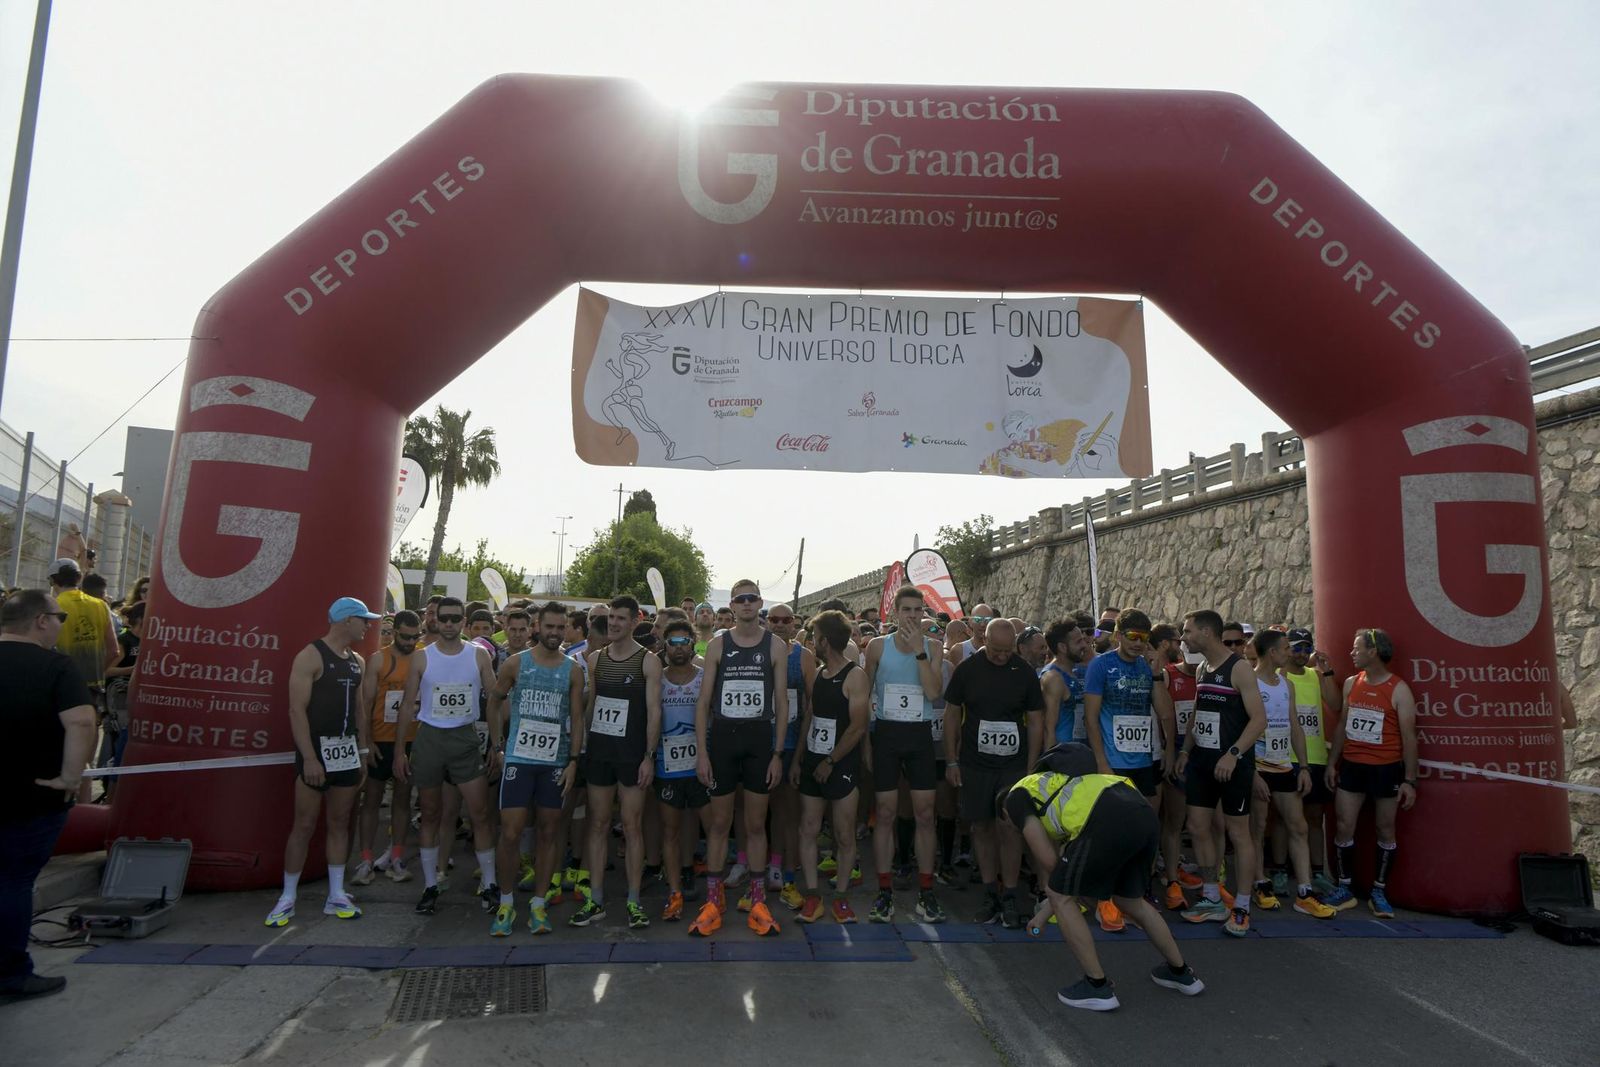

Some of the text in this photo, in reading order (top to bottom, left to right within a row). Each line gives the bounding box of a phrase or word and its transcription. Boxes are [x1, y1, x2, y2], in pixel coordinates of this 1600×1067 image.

[802, 90, 1061, 125] Diputación
[800, 130, 1062, 180] de Granada
[798, 197, 1058, 233] Avanzamos junt@s
[283, 156, 485, 315] DEPORTES
[1249, 176, 1441, 348] DEPORTES
[644, 297, 726, 329] XXXVI
[694, 355, 740, 367] Diputación
[693, 365, 740, 375] de Granada
[708, 397, 763, 408] Cruzcampo
[847, 407, 900, 417] Sabor Granada
[776, 433, 832, 453] Coca-Cola
[921, 435, 968, 446] Granada
[146, 616, 280, 651] Diputación
[141, 650, 275, 685] de Granada
[1411, 659, 1551, 688] Diputación
[136, 689, 270, 714] Avanzamos junt@s
[439, 693, 466, 706] 663
[520, 688, 563, 706] SELECCIÓN
[662, 696, 699, 704] MARACEN
[724, 692, 762, 706] 3136
[899, 695, 909, 708] 3
[1416, 692, 1448, 718] de
[1453, 692, 1553, 718] Granada
[597, 707, 621, 723] 117
[1298, 714, 1319, 727] 088
[1352, 717, 1376, 732] 677
[131, 718, 269, 749] DEPORTES
[518, 731, 557, 750] 3197
[981, 732, 1017, 746] 3120
[1116, 727, 1149, 741] 3007
[1417, 729, 1515, 746] Avanzamos
[670, 744, 696, 760] 670
[1271, 737, 1289, 750] 618
[323, 744, 356, 761] 3034
